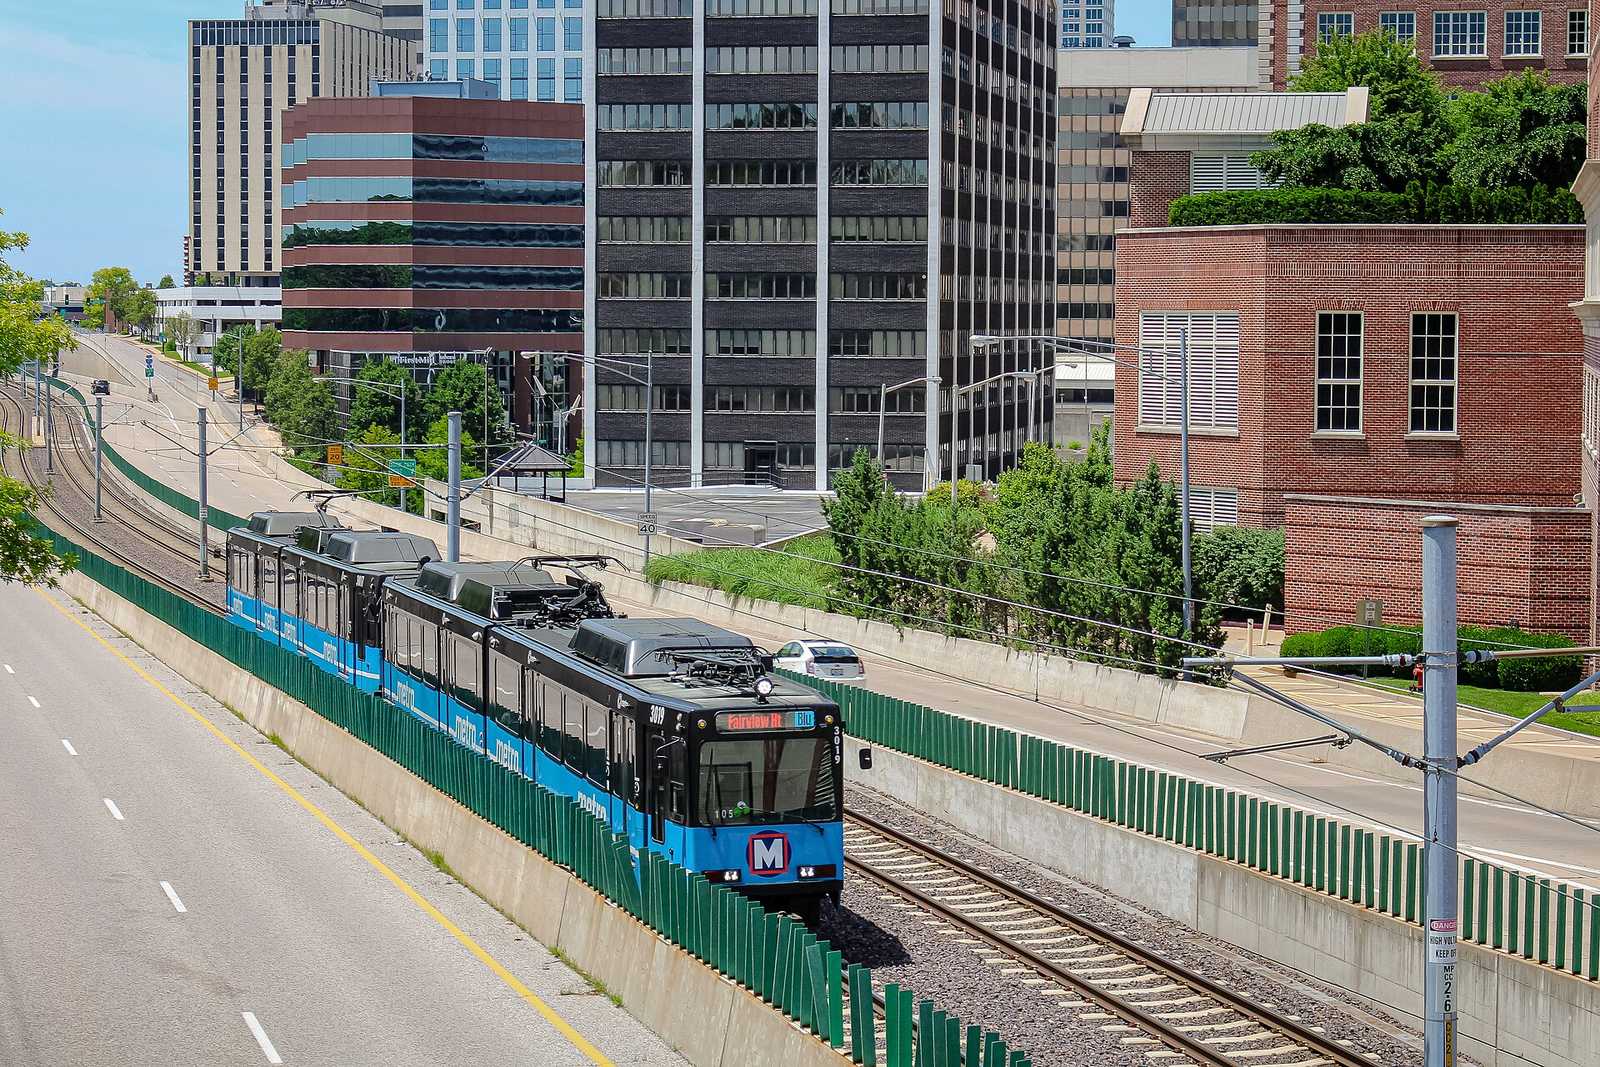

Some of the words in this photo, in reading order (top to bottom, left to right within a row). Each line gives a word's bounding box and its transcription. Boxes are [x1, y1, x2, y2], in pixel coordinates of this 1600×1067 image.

[640, 524, 656, 533] 40
[649, 705, 666, 725] 3019
[727, 712, 769, 730] Fairview
[456, 715, 477, 750] metro
[496, 739, 519, 772] metro
[715, 808, 734, 819] 105
[753, 838, 784, 870] M
[1429, 935, 1444, 945] HIGH
[1435, 949, 1450, 958] KEEP
[1443, 965, 1455, 973] MP
[1444, 973, 1454, 981] CC
